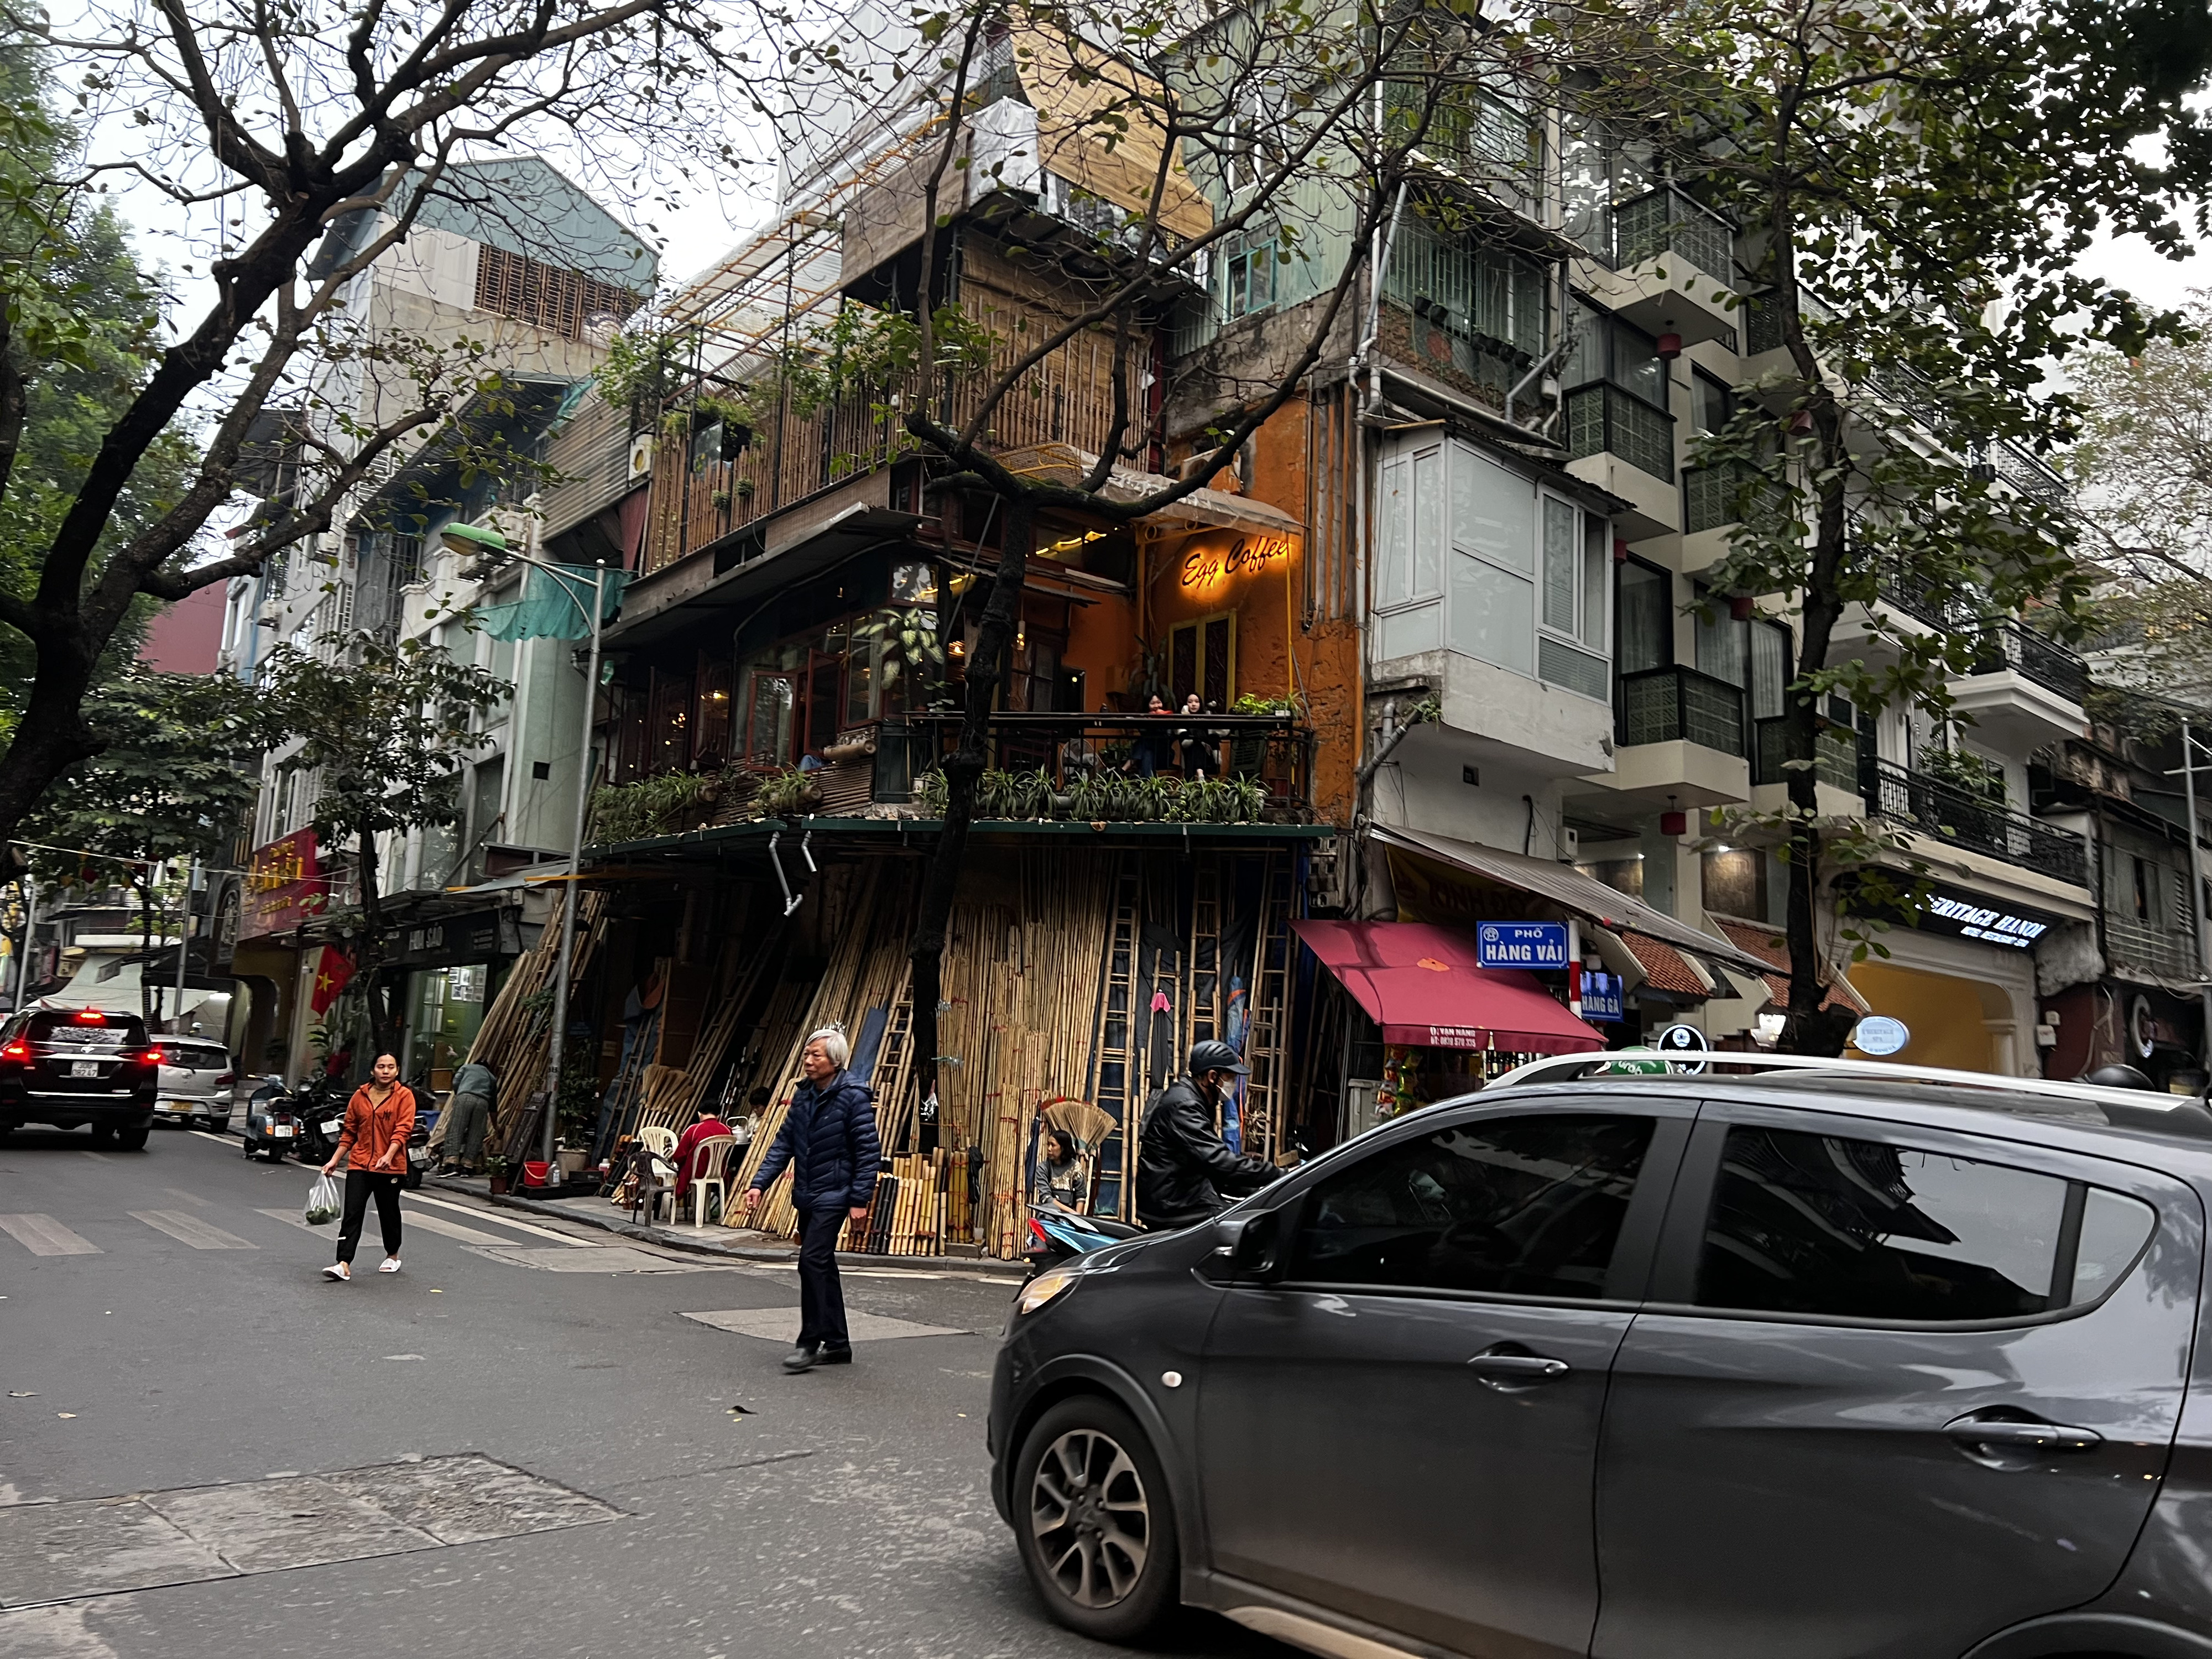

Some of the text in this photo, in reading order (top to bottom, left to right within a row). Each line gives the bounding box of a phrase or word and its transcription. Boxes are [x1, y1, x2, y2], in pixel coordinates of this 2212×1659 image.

[1182, 535, 1288, 589] Egg Coffee
[1515, 926, 1545, 938] PHỐ
[1993, 915, 2047, 938] HANOI
[1485, 938, 1563, 961] HÀNG VẢI
[1582, 991, 1620, 1014] HÀNG GÀ
